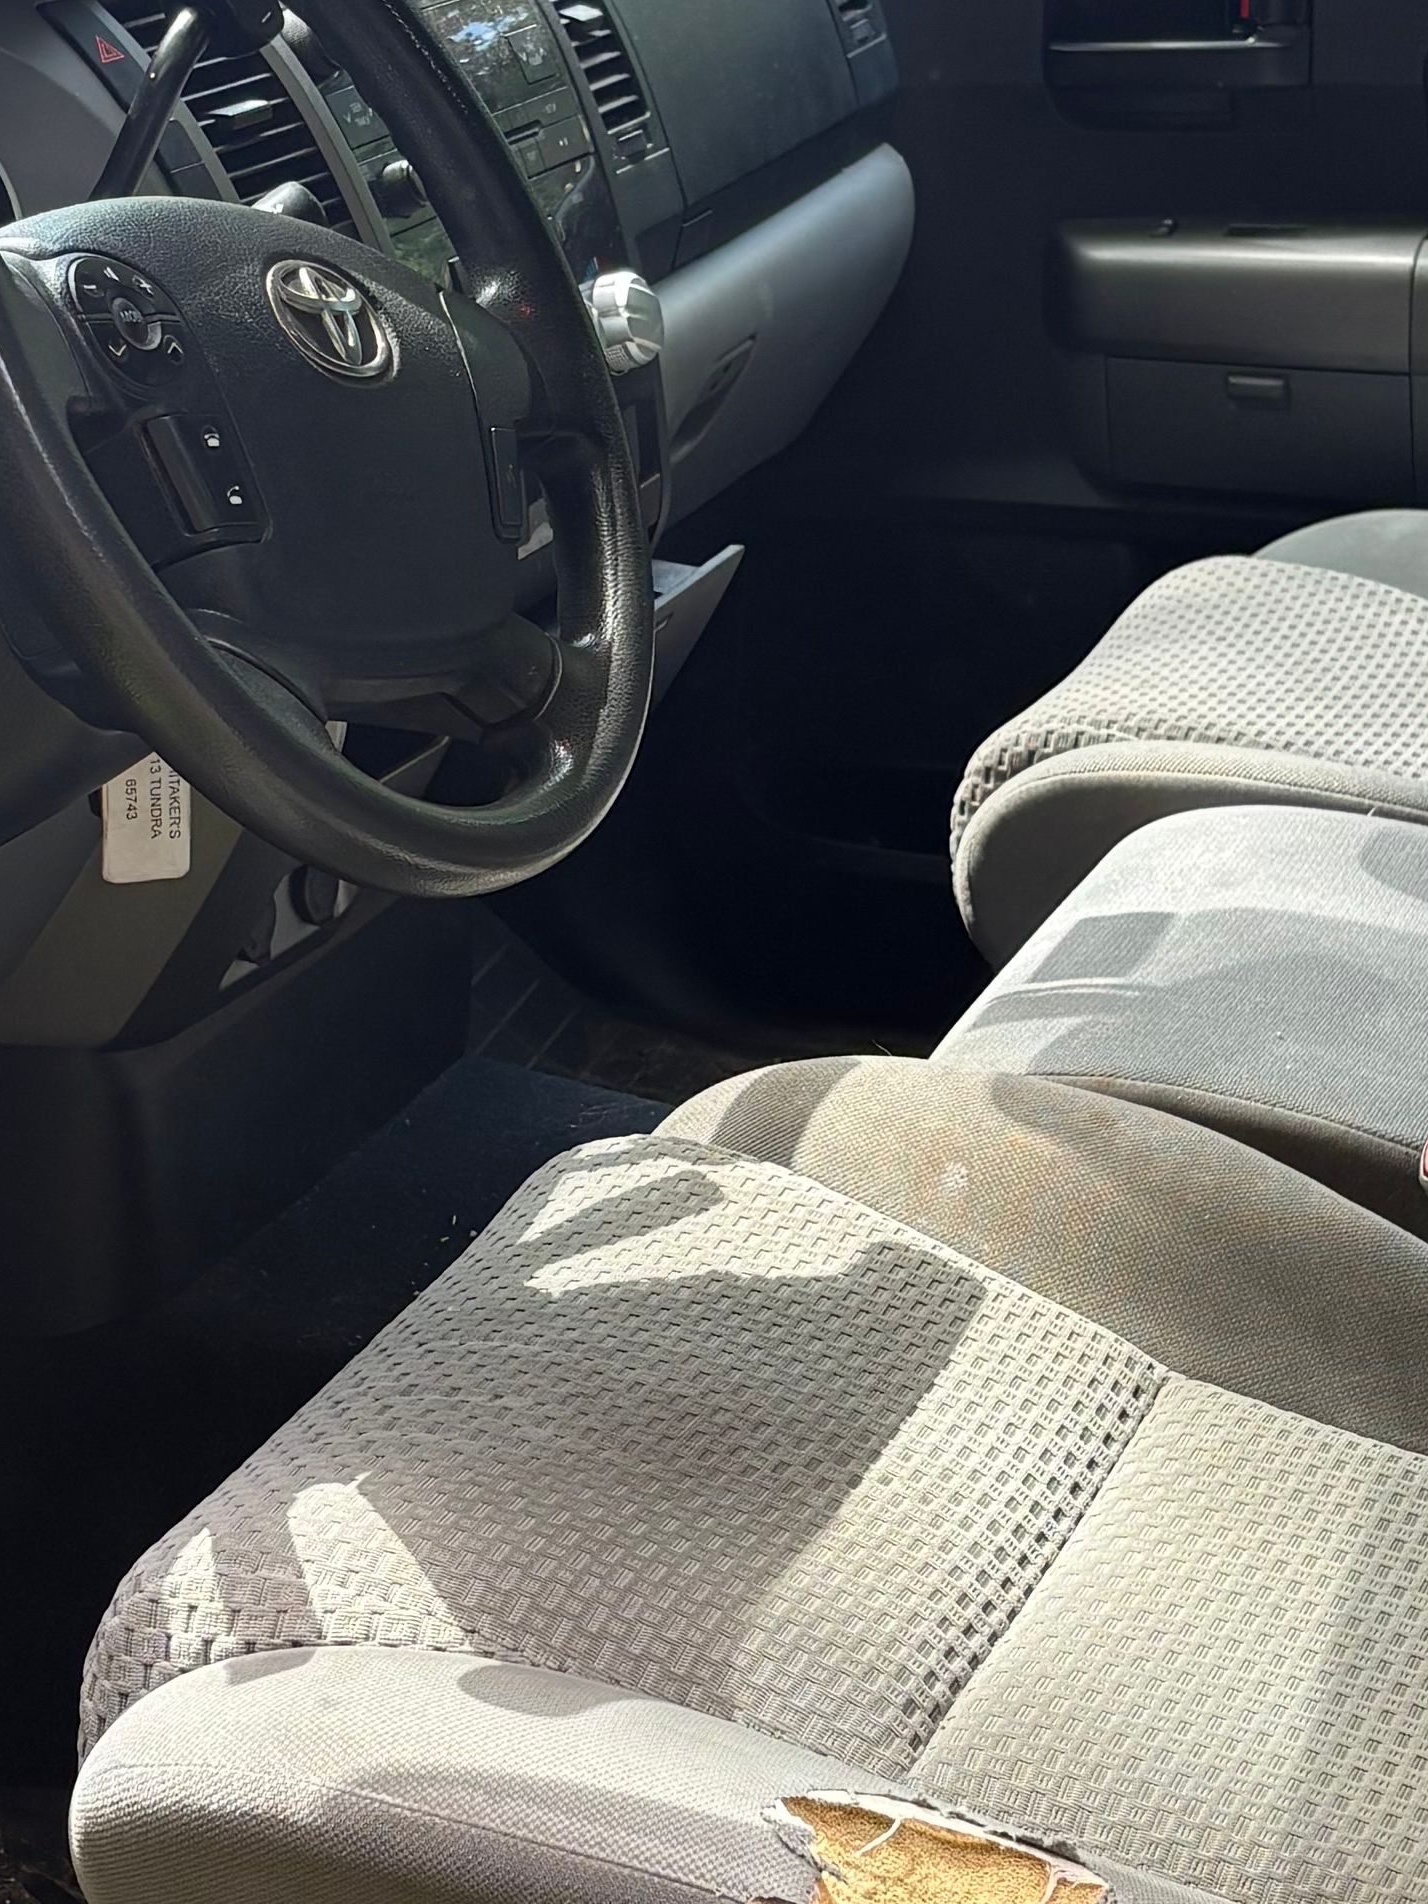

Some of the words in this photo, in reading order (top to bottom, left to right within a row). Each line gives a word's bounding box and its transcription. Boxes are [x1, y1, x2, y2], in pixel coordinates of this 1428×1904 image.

[125, 778, 138, 820] 65743
[149, 777, 163, 839] TUNDRA
[168, 769, 182, 839] ITAKER'S
